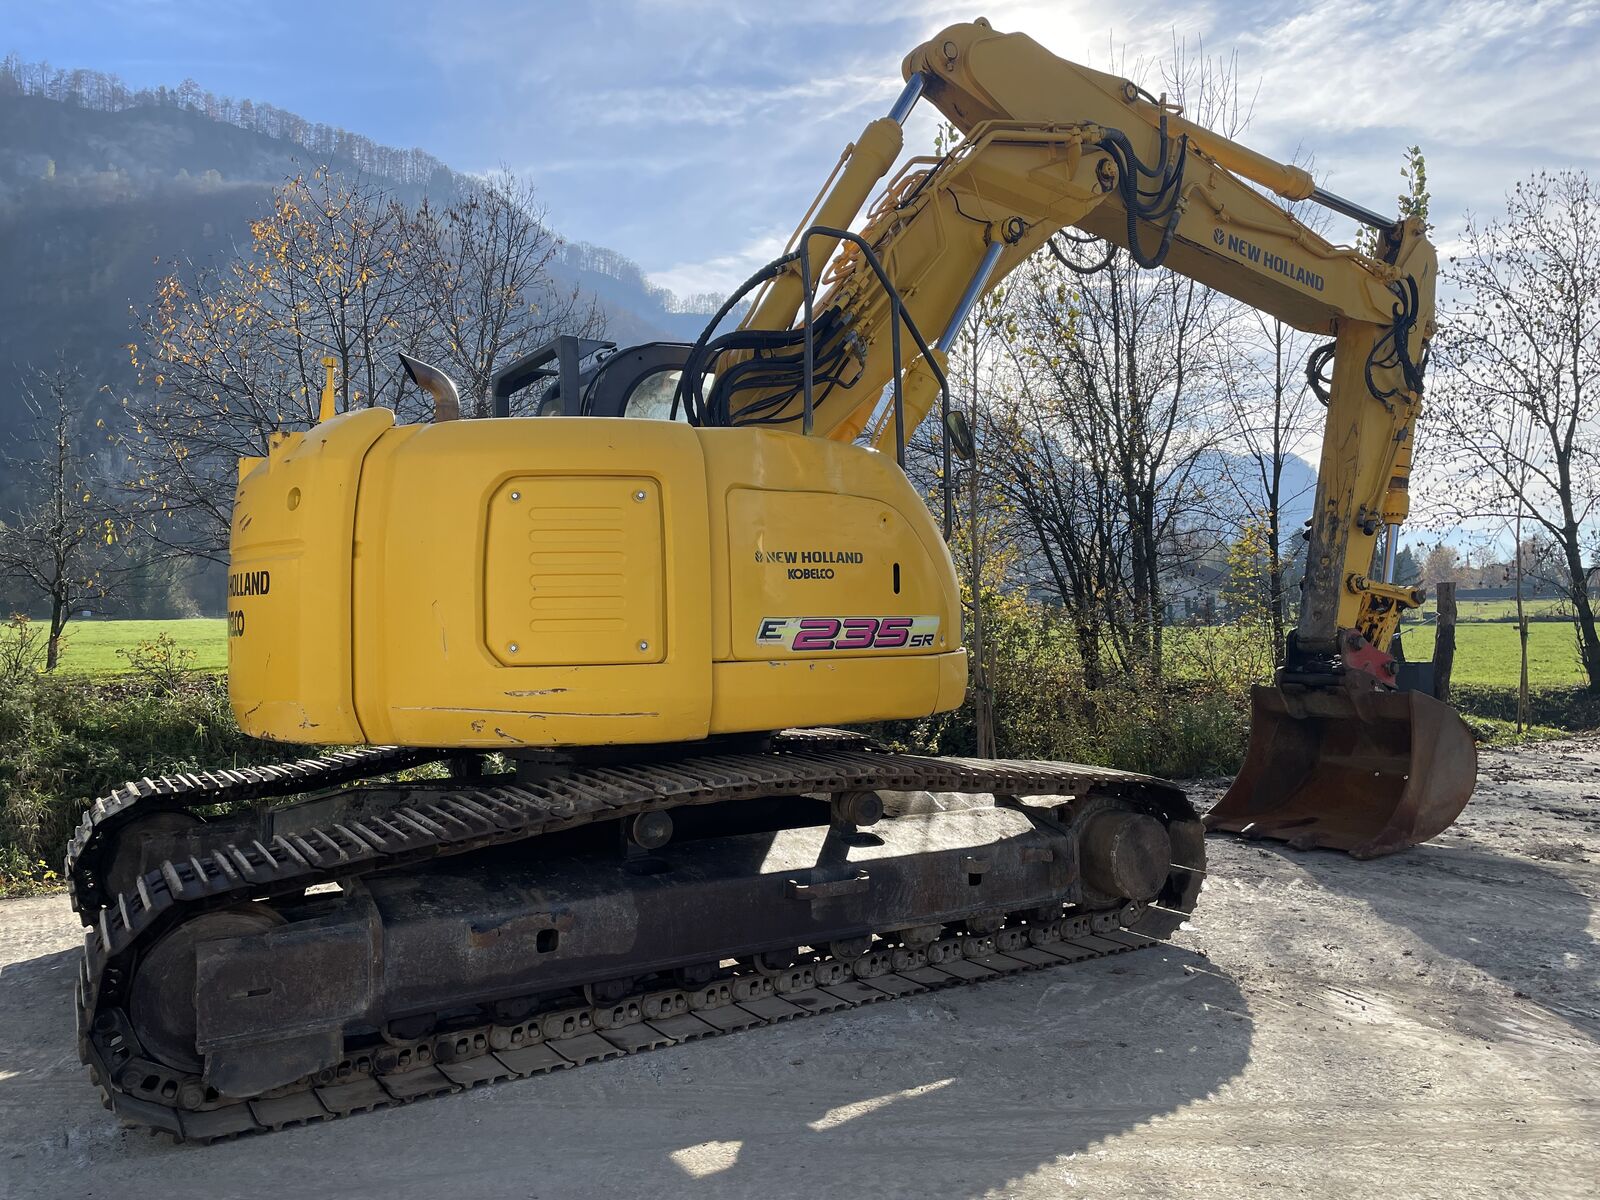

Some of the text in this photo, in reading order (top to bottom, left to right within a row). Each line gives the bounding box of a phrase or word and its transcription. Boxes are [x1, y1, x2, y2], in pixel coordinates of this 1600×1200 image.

[1228, 234, 1324, 291] NEW HOLLAND
[766, 551, 863, 564] NEW HOLLAND
[787, 568, 834, 580] KOBELCO
[758, 618, 934, 650] E 235 SR
